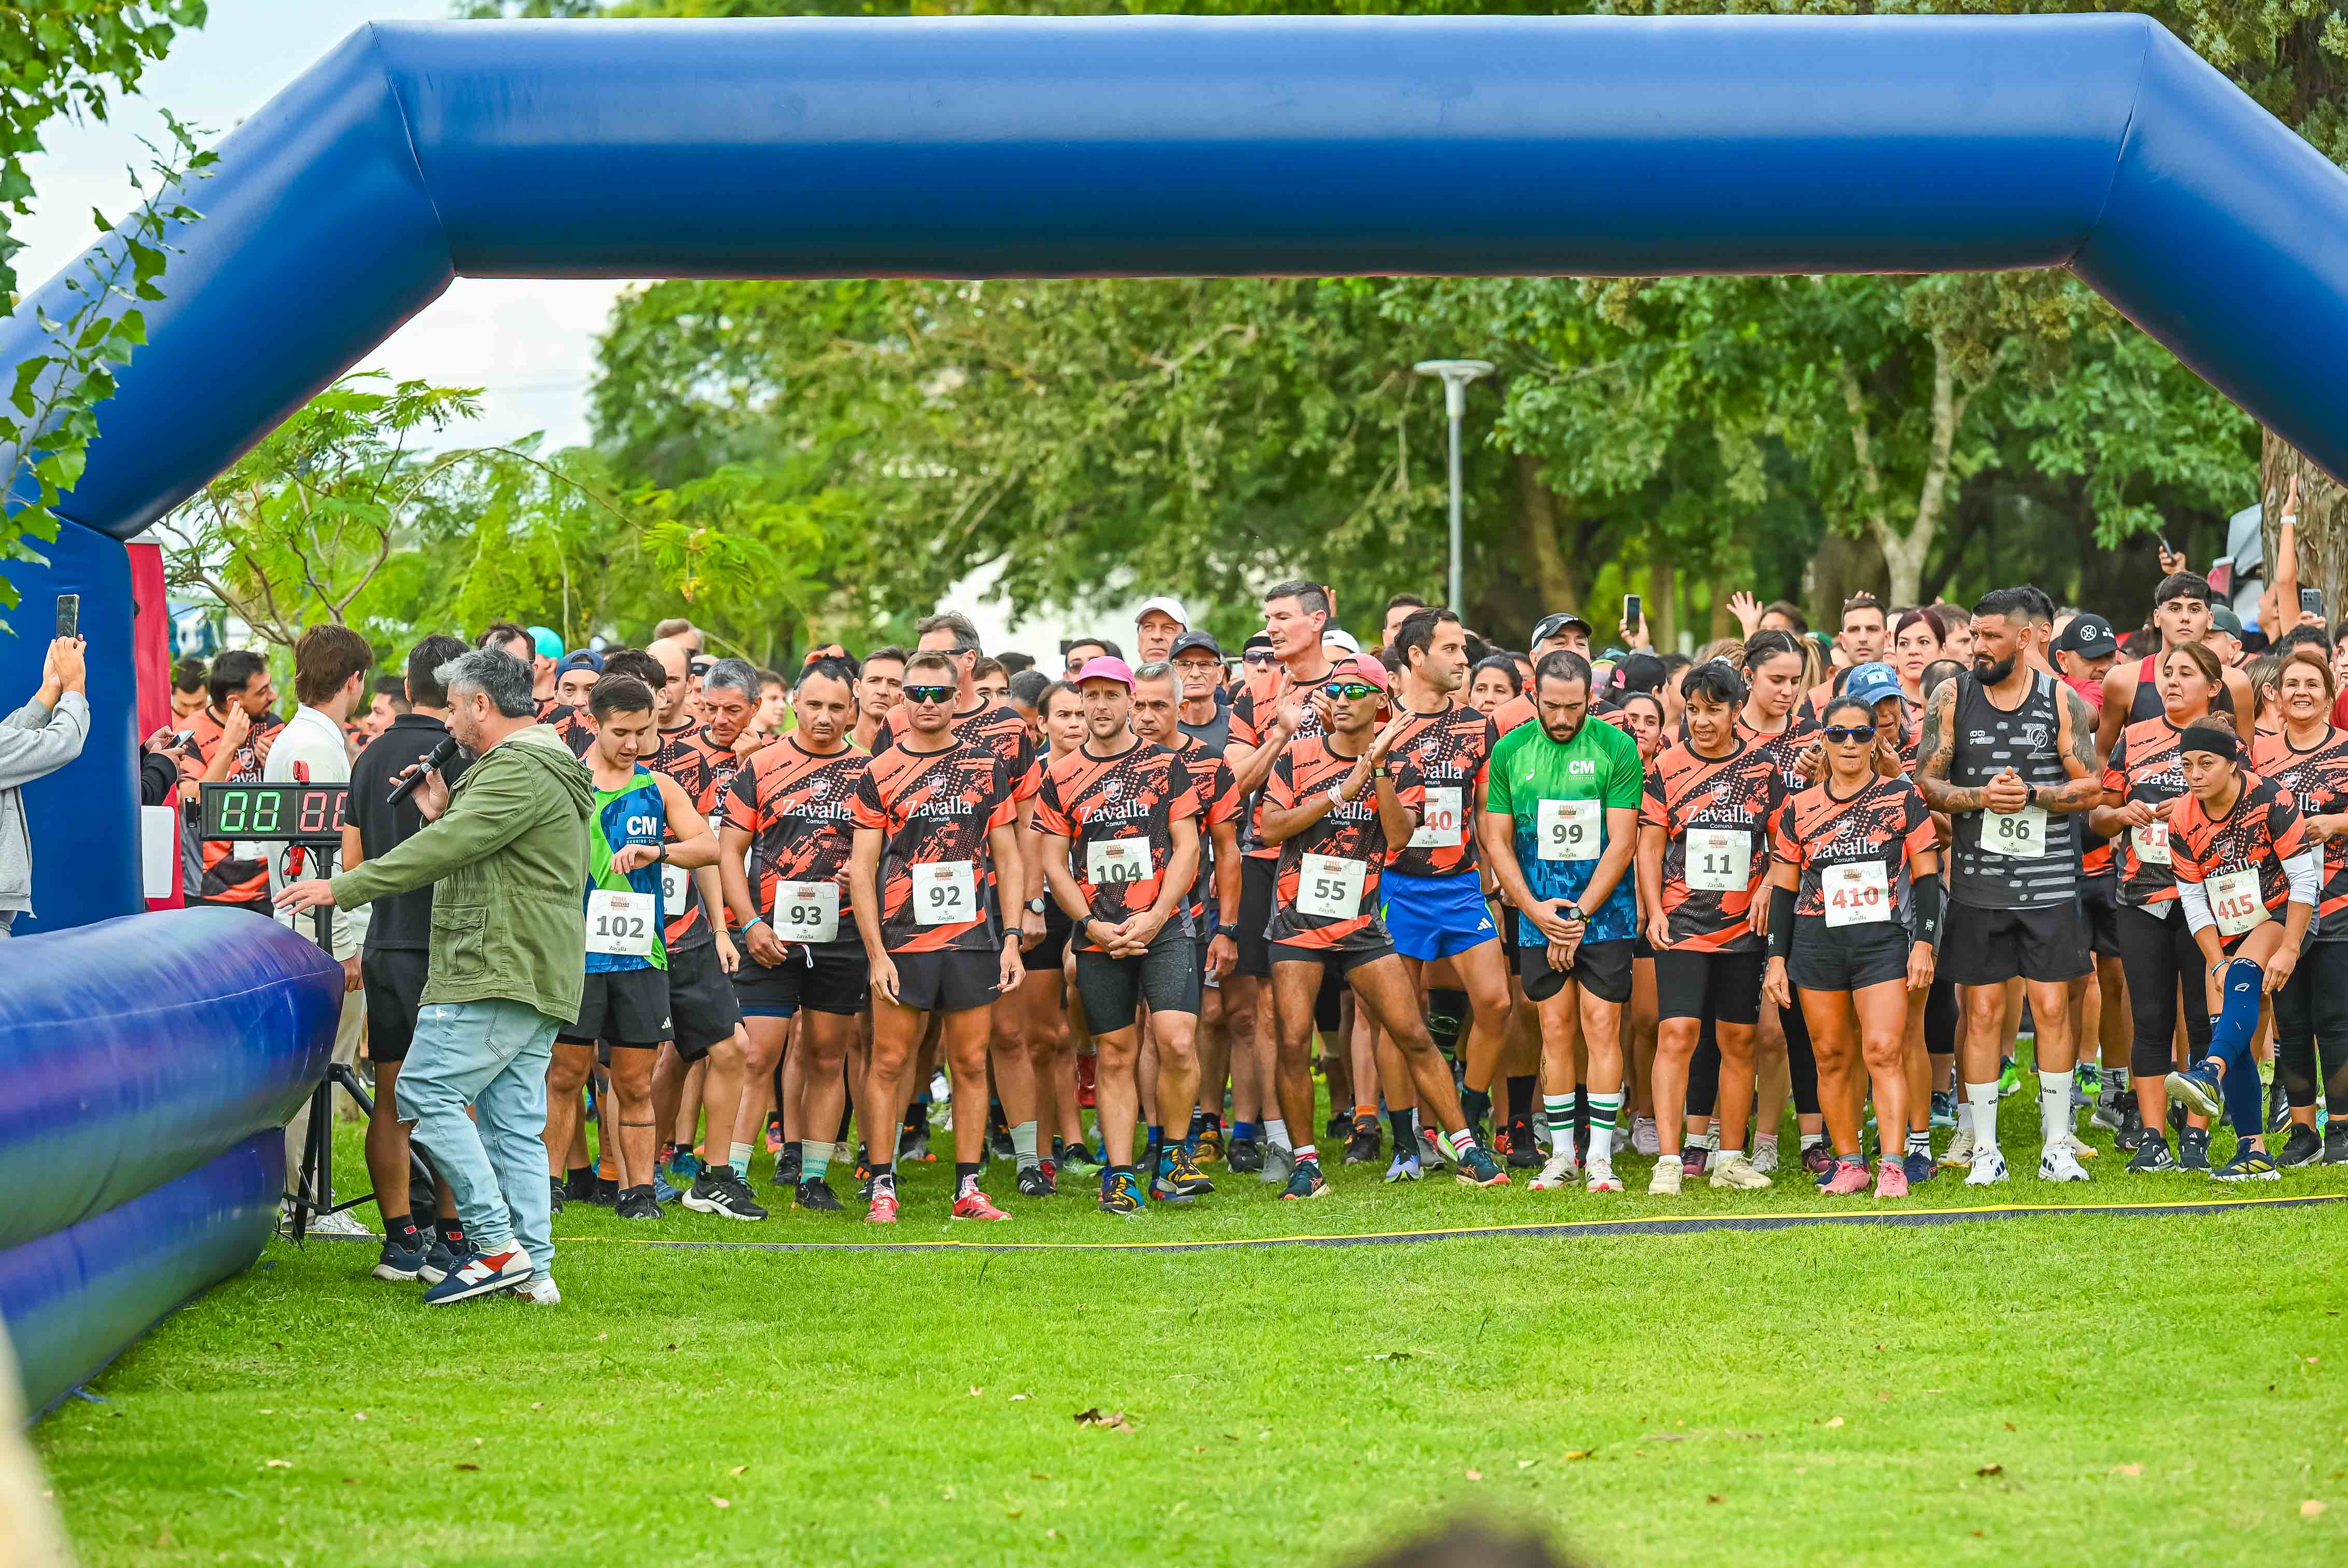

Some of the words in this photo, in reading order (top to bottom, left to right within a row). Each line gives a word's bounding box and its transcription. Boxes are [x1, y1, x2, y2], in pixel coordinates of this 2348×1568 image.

[1421, 760, 1463, 779] valla
[1569, 760, 1595, 775] CM
[2137, 768, 2189, 787] Zava
[220, 791, 282, 831] 00
[782, 799, 852, 821] Zavalla
[905, 795, 973, 819] Zavalla
[1079, 798, 1150, 824] Zavalla
[1323, 801, 1373, 821] valla
[1686, 804, 1754, 824] Zavalla
[626, 816, 658, 836] CM
[1105, 819, 1127, 828] Comuna
[1414, 810, 1452, 831] 40
[1998, 817, 2030, 839] 86
[1553, 824, 1583, 844] 99
[2139, 827, 2169, 847] 41
[1811, 836, 1880, 860] Zavalla
[1097, 861, 1143, 884] 104
[1703, 854, 1732, 874] 11
[930, 886, 961, 907] 92
[1315, 878, 1346, 901] 55
[1832, 886, 1879, 908] 410
[791, 905, 821, 926] 93
[2218, 893, 2255, 920] 415
[596, 915, 644, 938] 102
